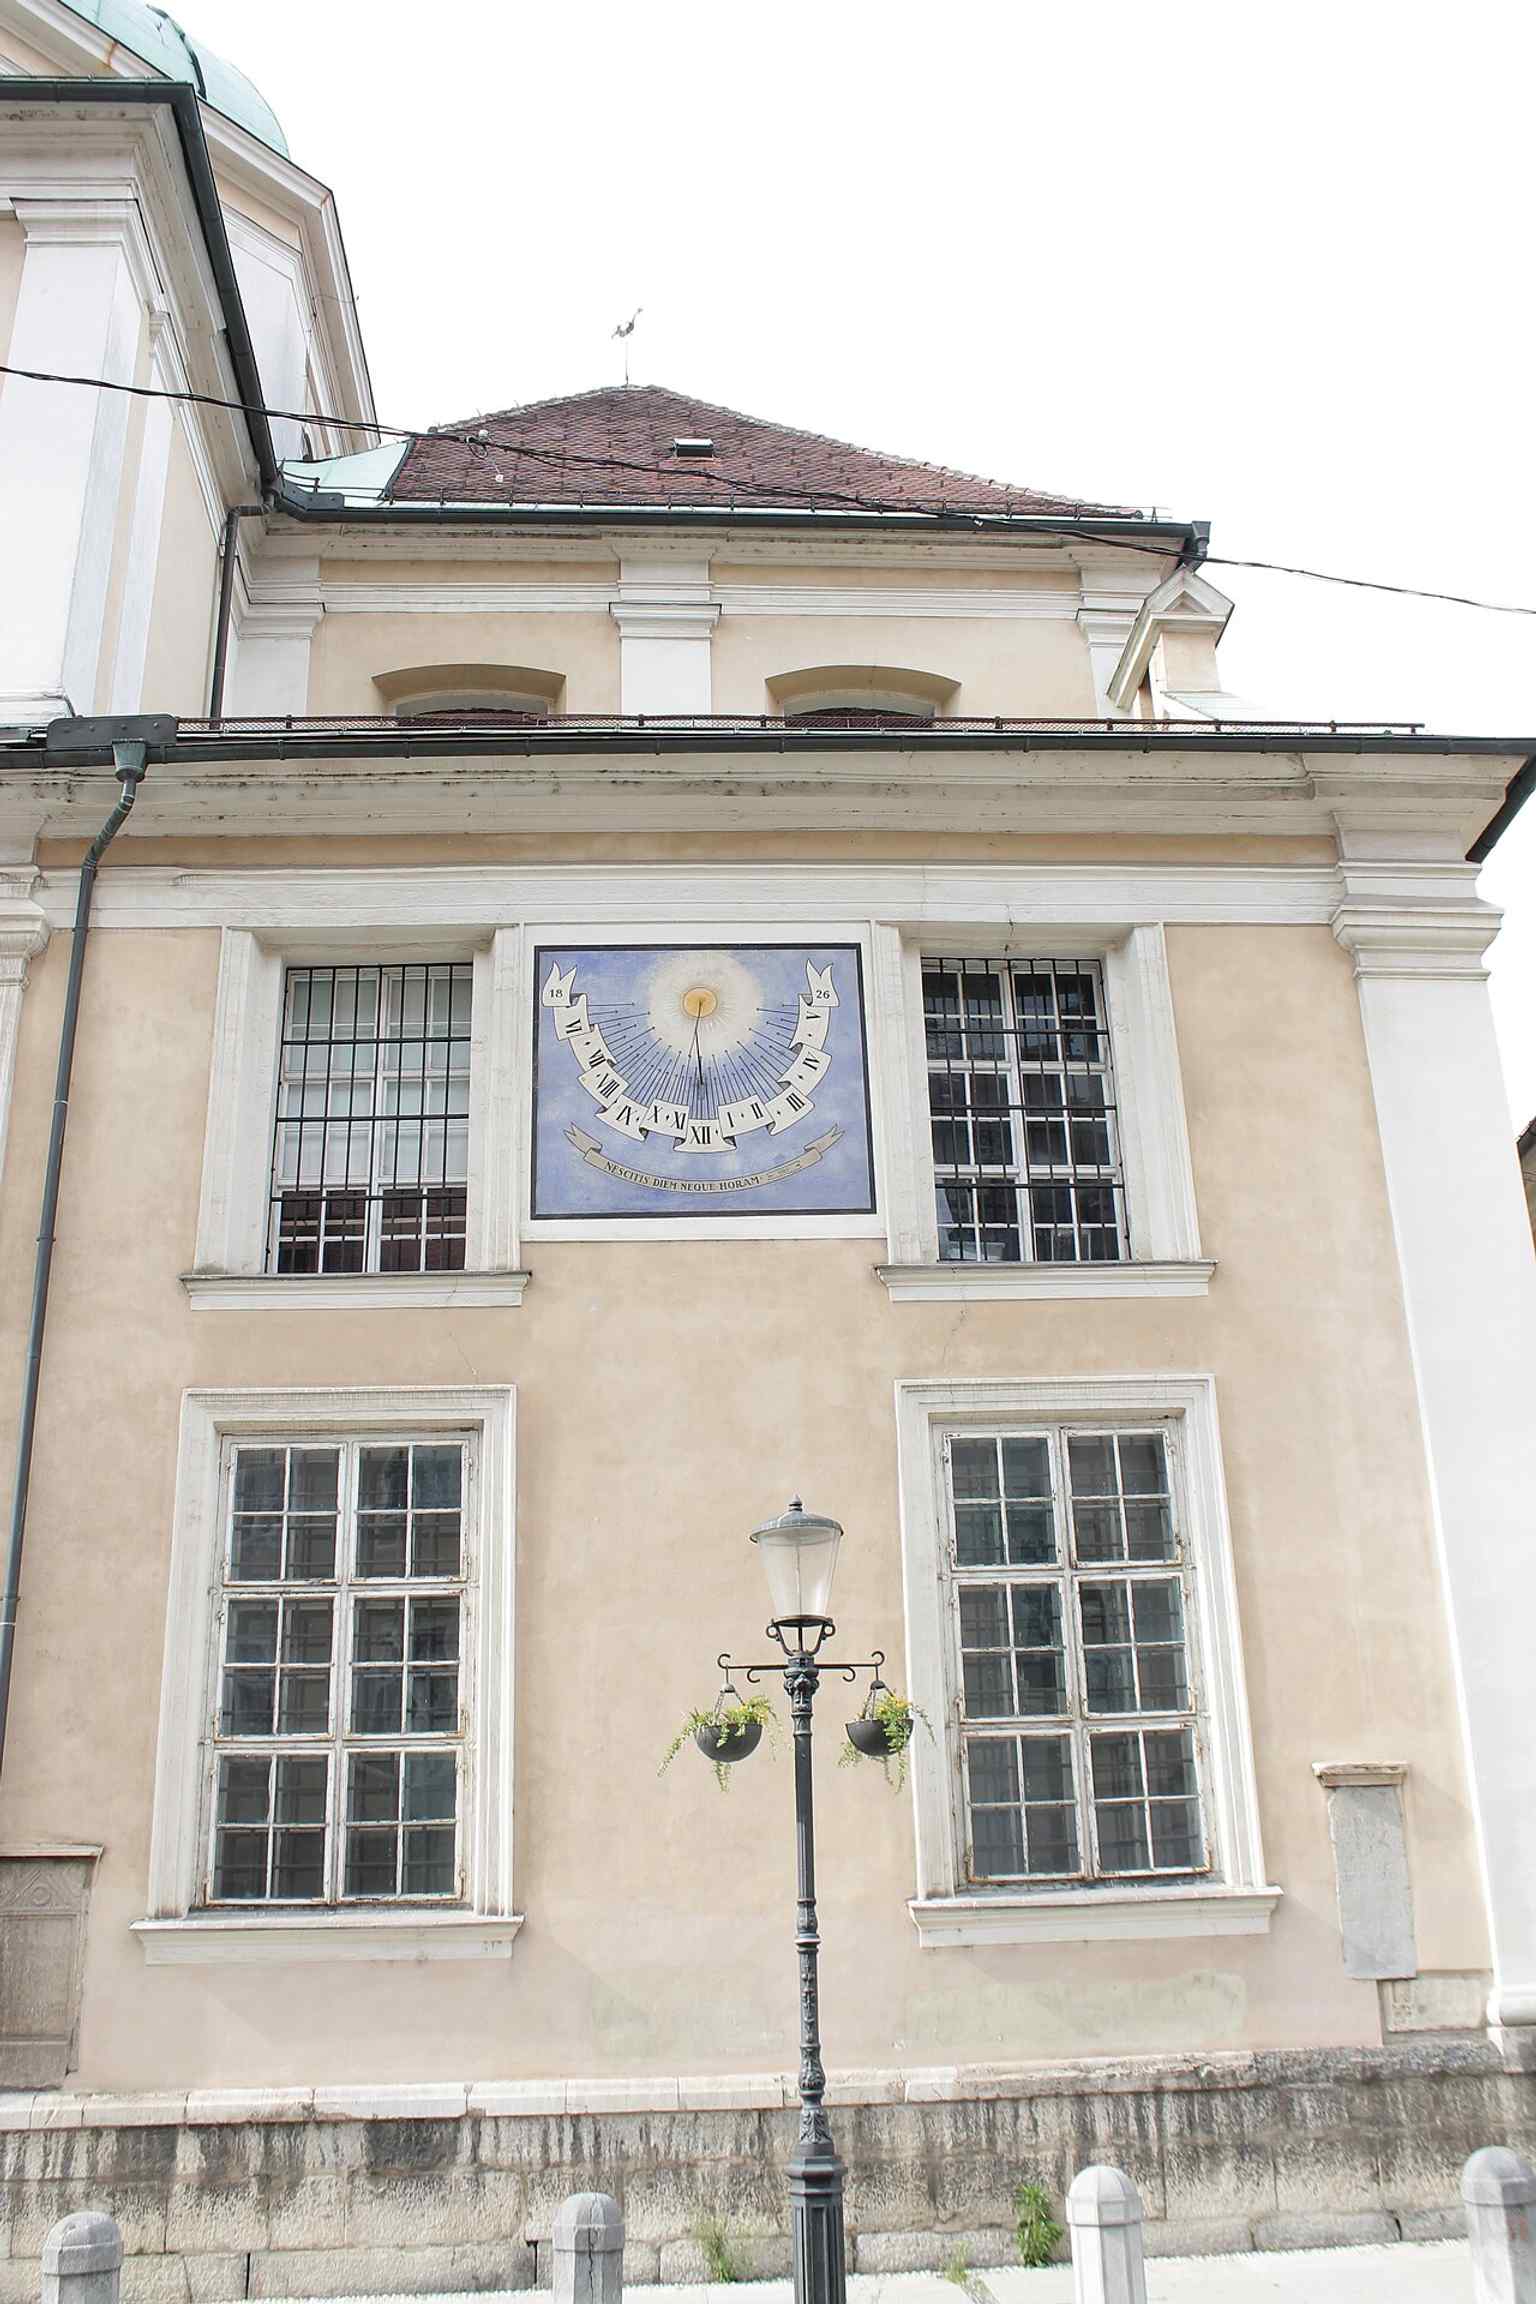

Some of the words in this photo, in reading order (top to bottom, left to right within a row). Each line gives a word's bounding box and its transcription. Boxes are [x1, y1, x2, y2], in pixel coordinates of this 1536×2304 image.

[549, 988, 563, 999] 18
[816, 988, 831, 1000] 26
[565, 1018, 582, 1034] VI
[588, 1049, 606, 1068] VII
[616, 1104, 636, 1126] IX
[649, 1105, 662, 1124] X
[673, 1111, 687, 1130] XI
[690, 1125, 711, 1145] XII
[751, 1102, 764, 1119] II
[787, 1092, 806, 1111] III
[652, 1177, 677, 1190] DIEM
[680, 1182, 717, 1192] NEQUE
[719, 1175, 760, 1191] HORAM
